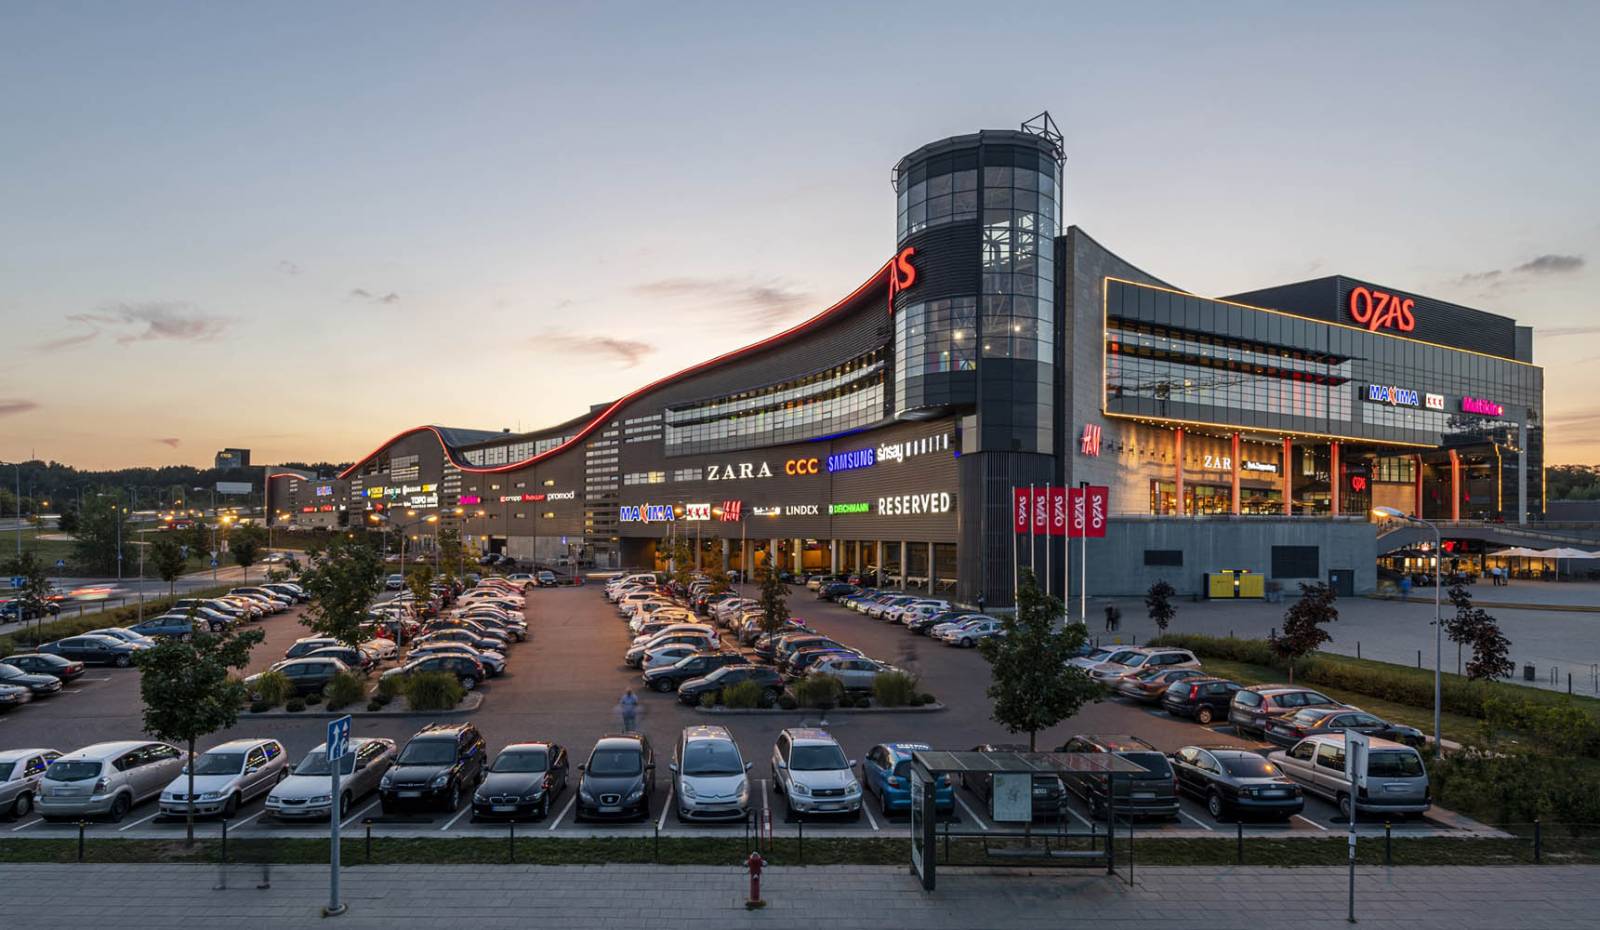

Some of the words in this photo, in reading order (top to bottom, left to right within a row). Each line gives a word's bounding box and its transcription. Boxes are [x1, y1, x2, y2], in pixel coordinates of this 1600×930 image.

[1350, 286, 1416, 331] OZAS
[1368, 384, 1419, 406] MAXIMA
[828, 449, 875, 473] SAMSUNG
[877, 442, 904, 463] sinsay
[1204, 455, 1232, 469] ZAR
[707, 461, 773, 481] ZARA
[785, 457, 819, 476] CCC
[547, 490, 575, 502] promod
[878, 492, 950, 516] RESERVED
[619, 502, 674, 525] MAXIMA
[785, 505, 819, 516] LINDEX
[832, 502, 869, 514] DEICHMANN
[1018, 496, 1027, 525] OZAS
[1036, 495, 1046, 526] OZAS
[1054, 495, 1065, 527] OZAS
[1092, 495, 1104, 528] OZAS
